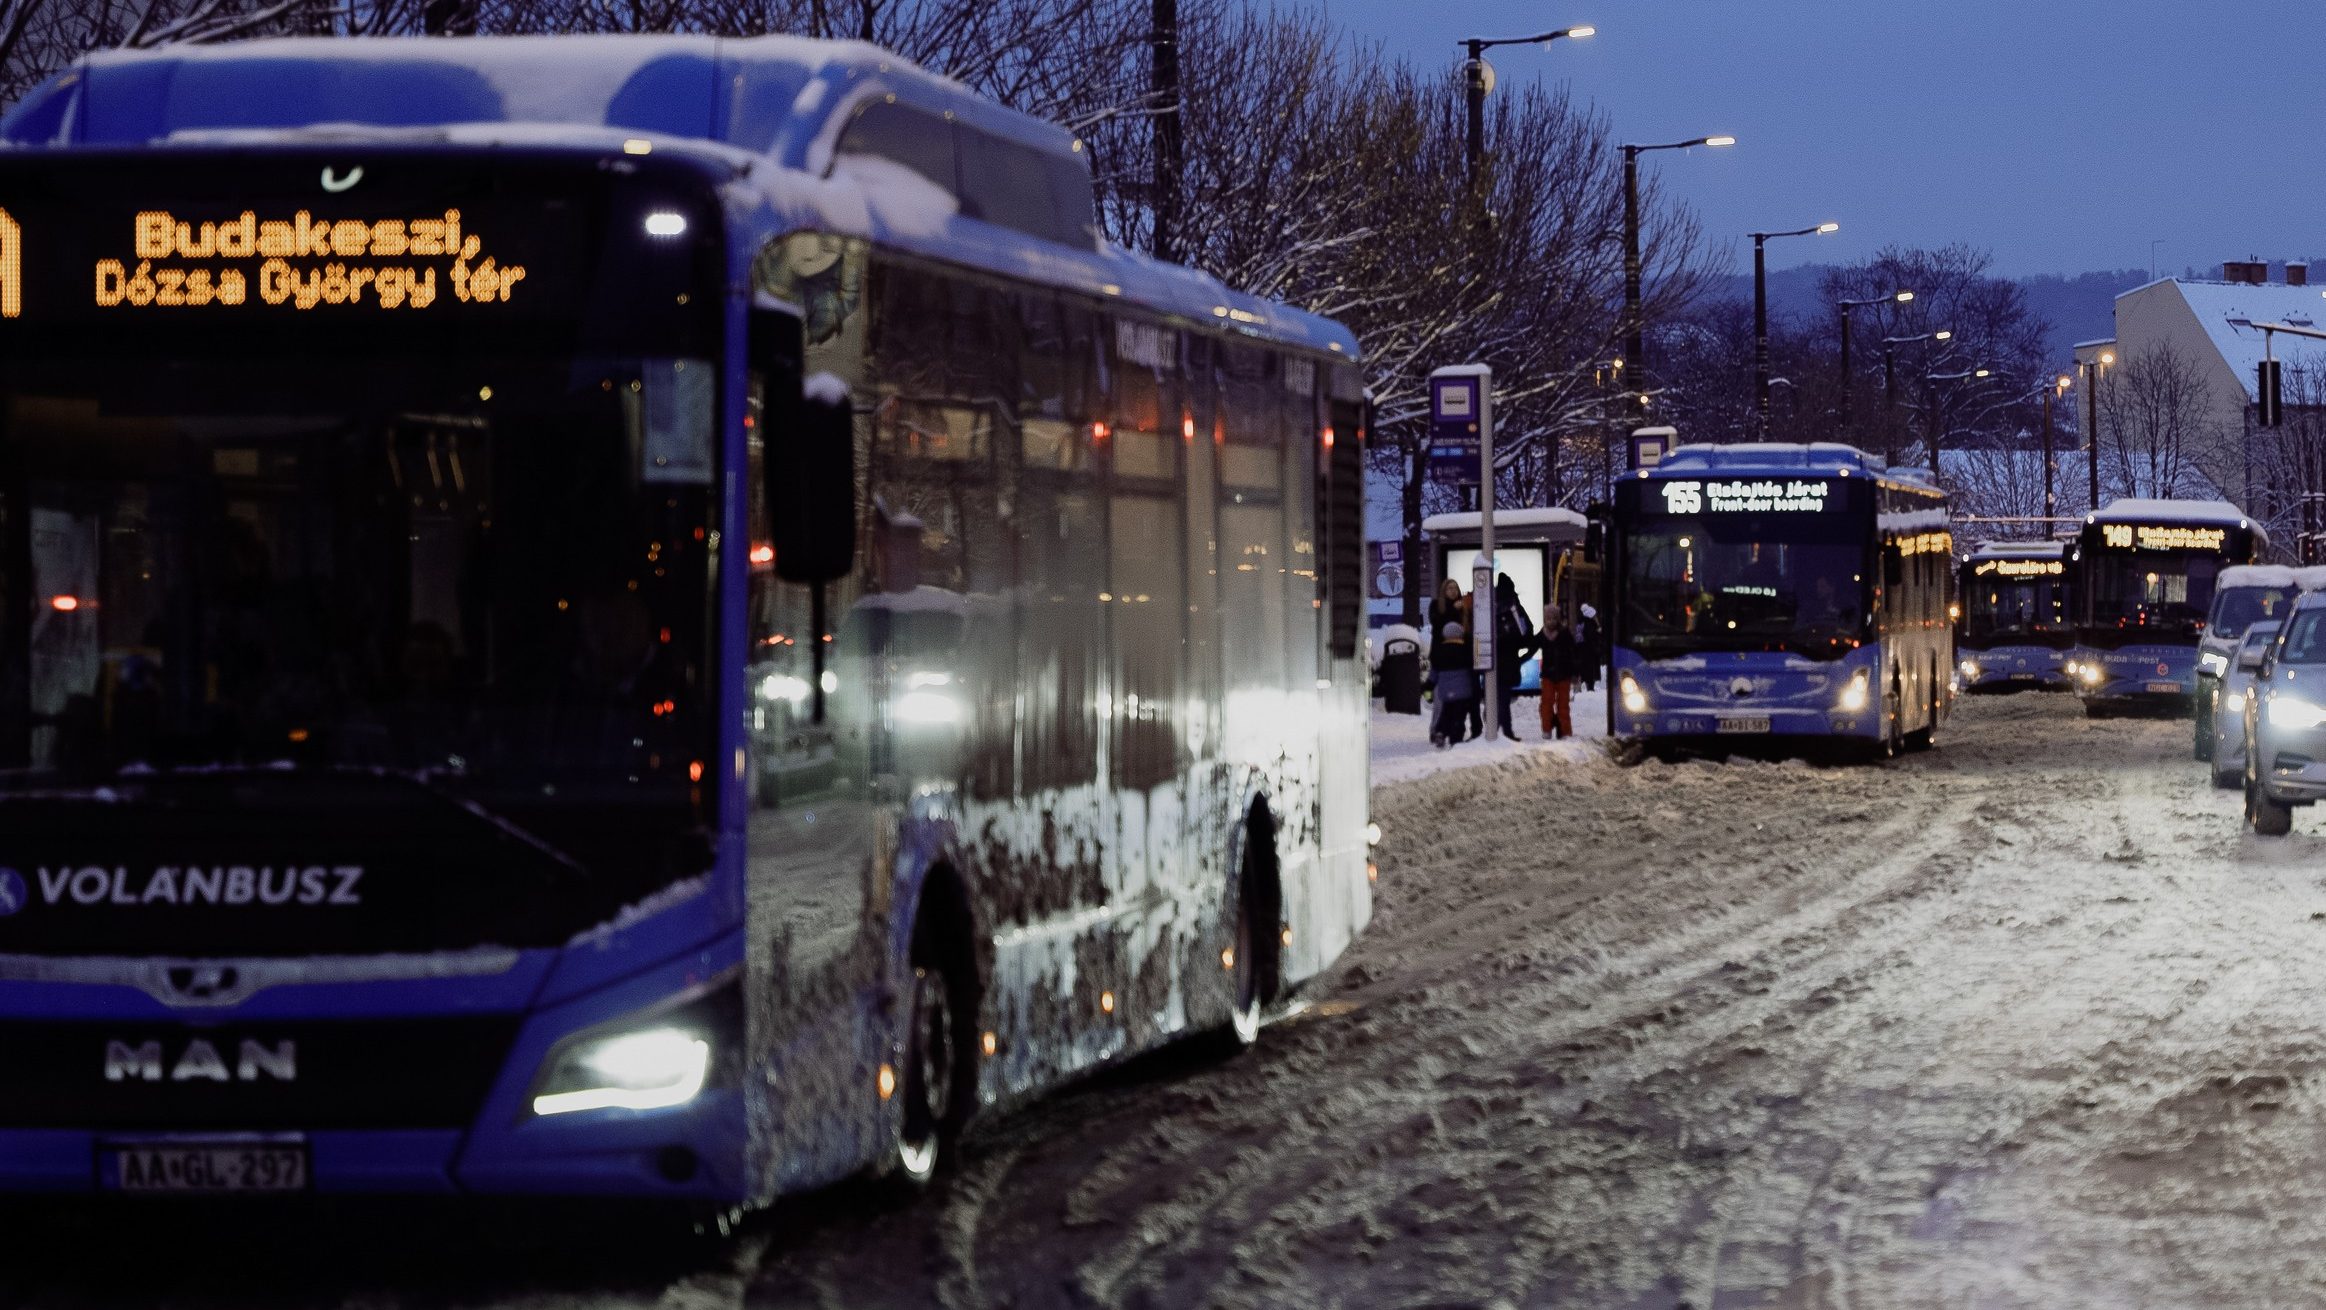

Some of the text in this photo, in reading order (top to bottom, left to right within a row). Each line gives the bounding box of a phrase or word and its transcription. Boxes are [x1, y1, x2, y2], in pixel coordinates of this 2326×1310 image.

[136, 209, 480, 259] Budakeszi,
[96, 256, 526, 309] Dózsa György tér
[1662, 481, 1701, 514] 155
[37, 866, 364, 904] VOLÁNBUSZ
[104, 1038, 297, 1081] MAN
